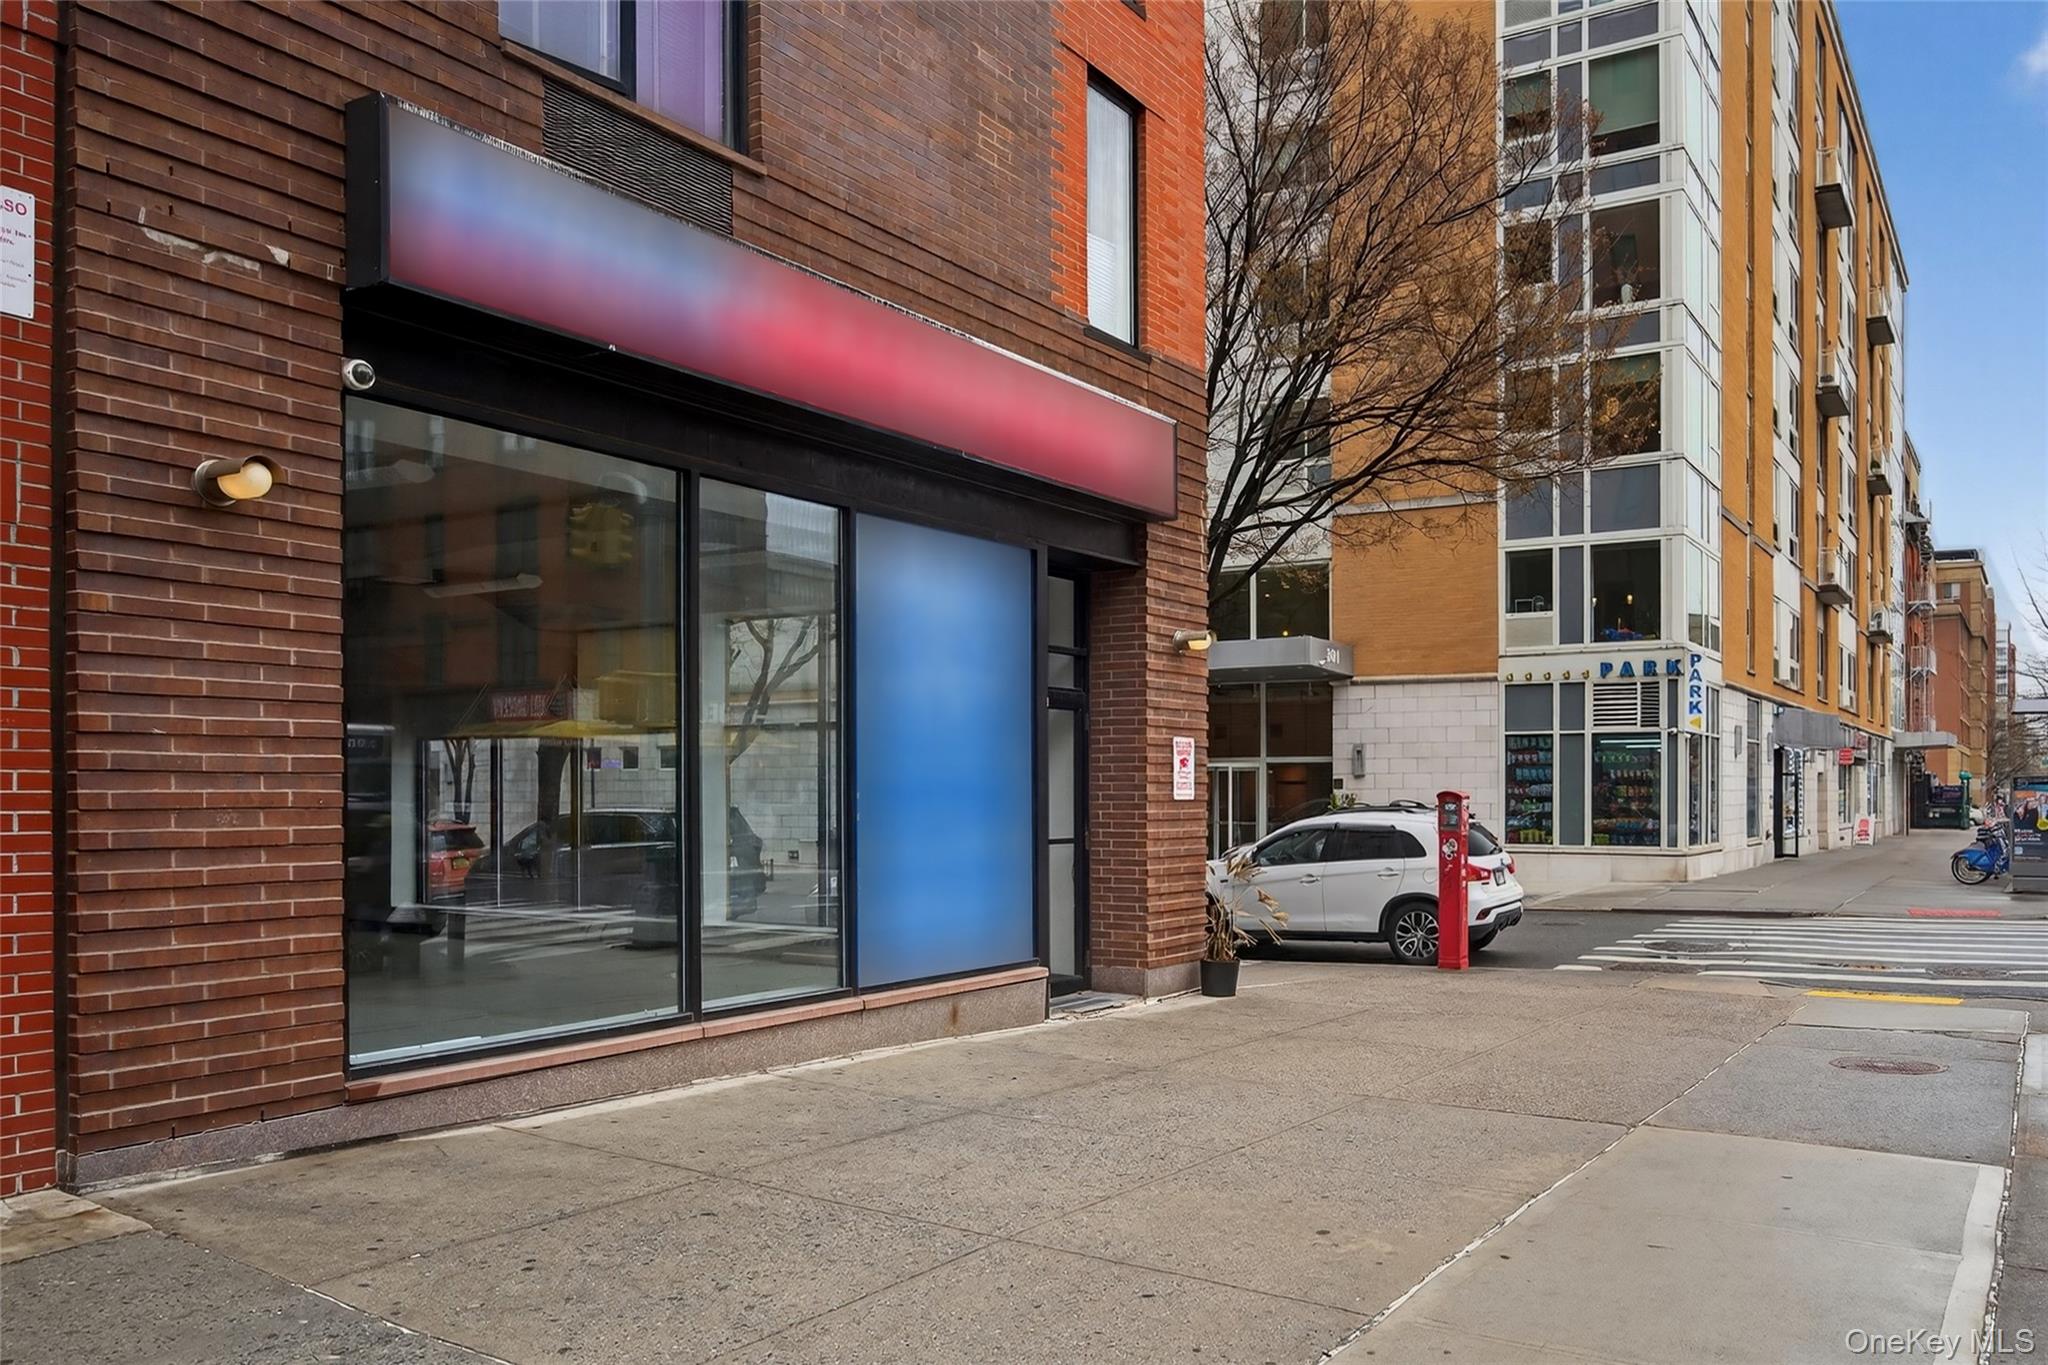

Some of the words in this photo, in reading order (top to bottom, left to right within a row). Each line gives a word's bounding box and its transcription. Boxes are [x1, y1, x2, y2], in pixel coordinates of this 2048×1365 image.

[0, 199, 27, 216] SO
[1600, 658, 1682, 679] PARK
[1689, 653, 1703, 715] PARK
